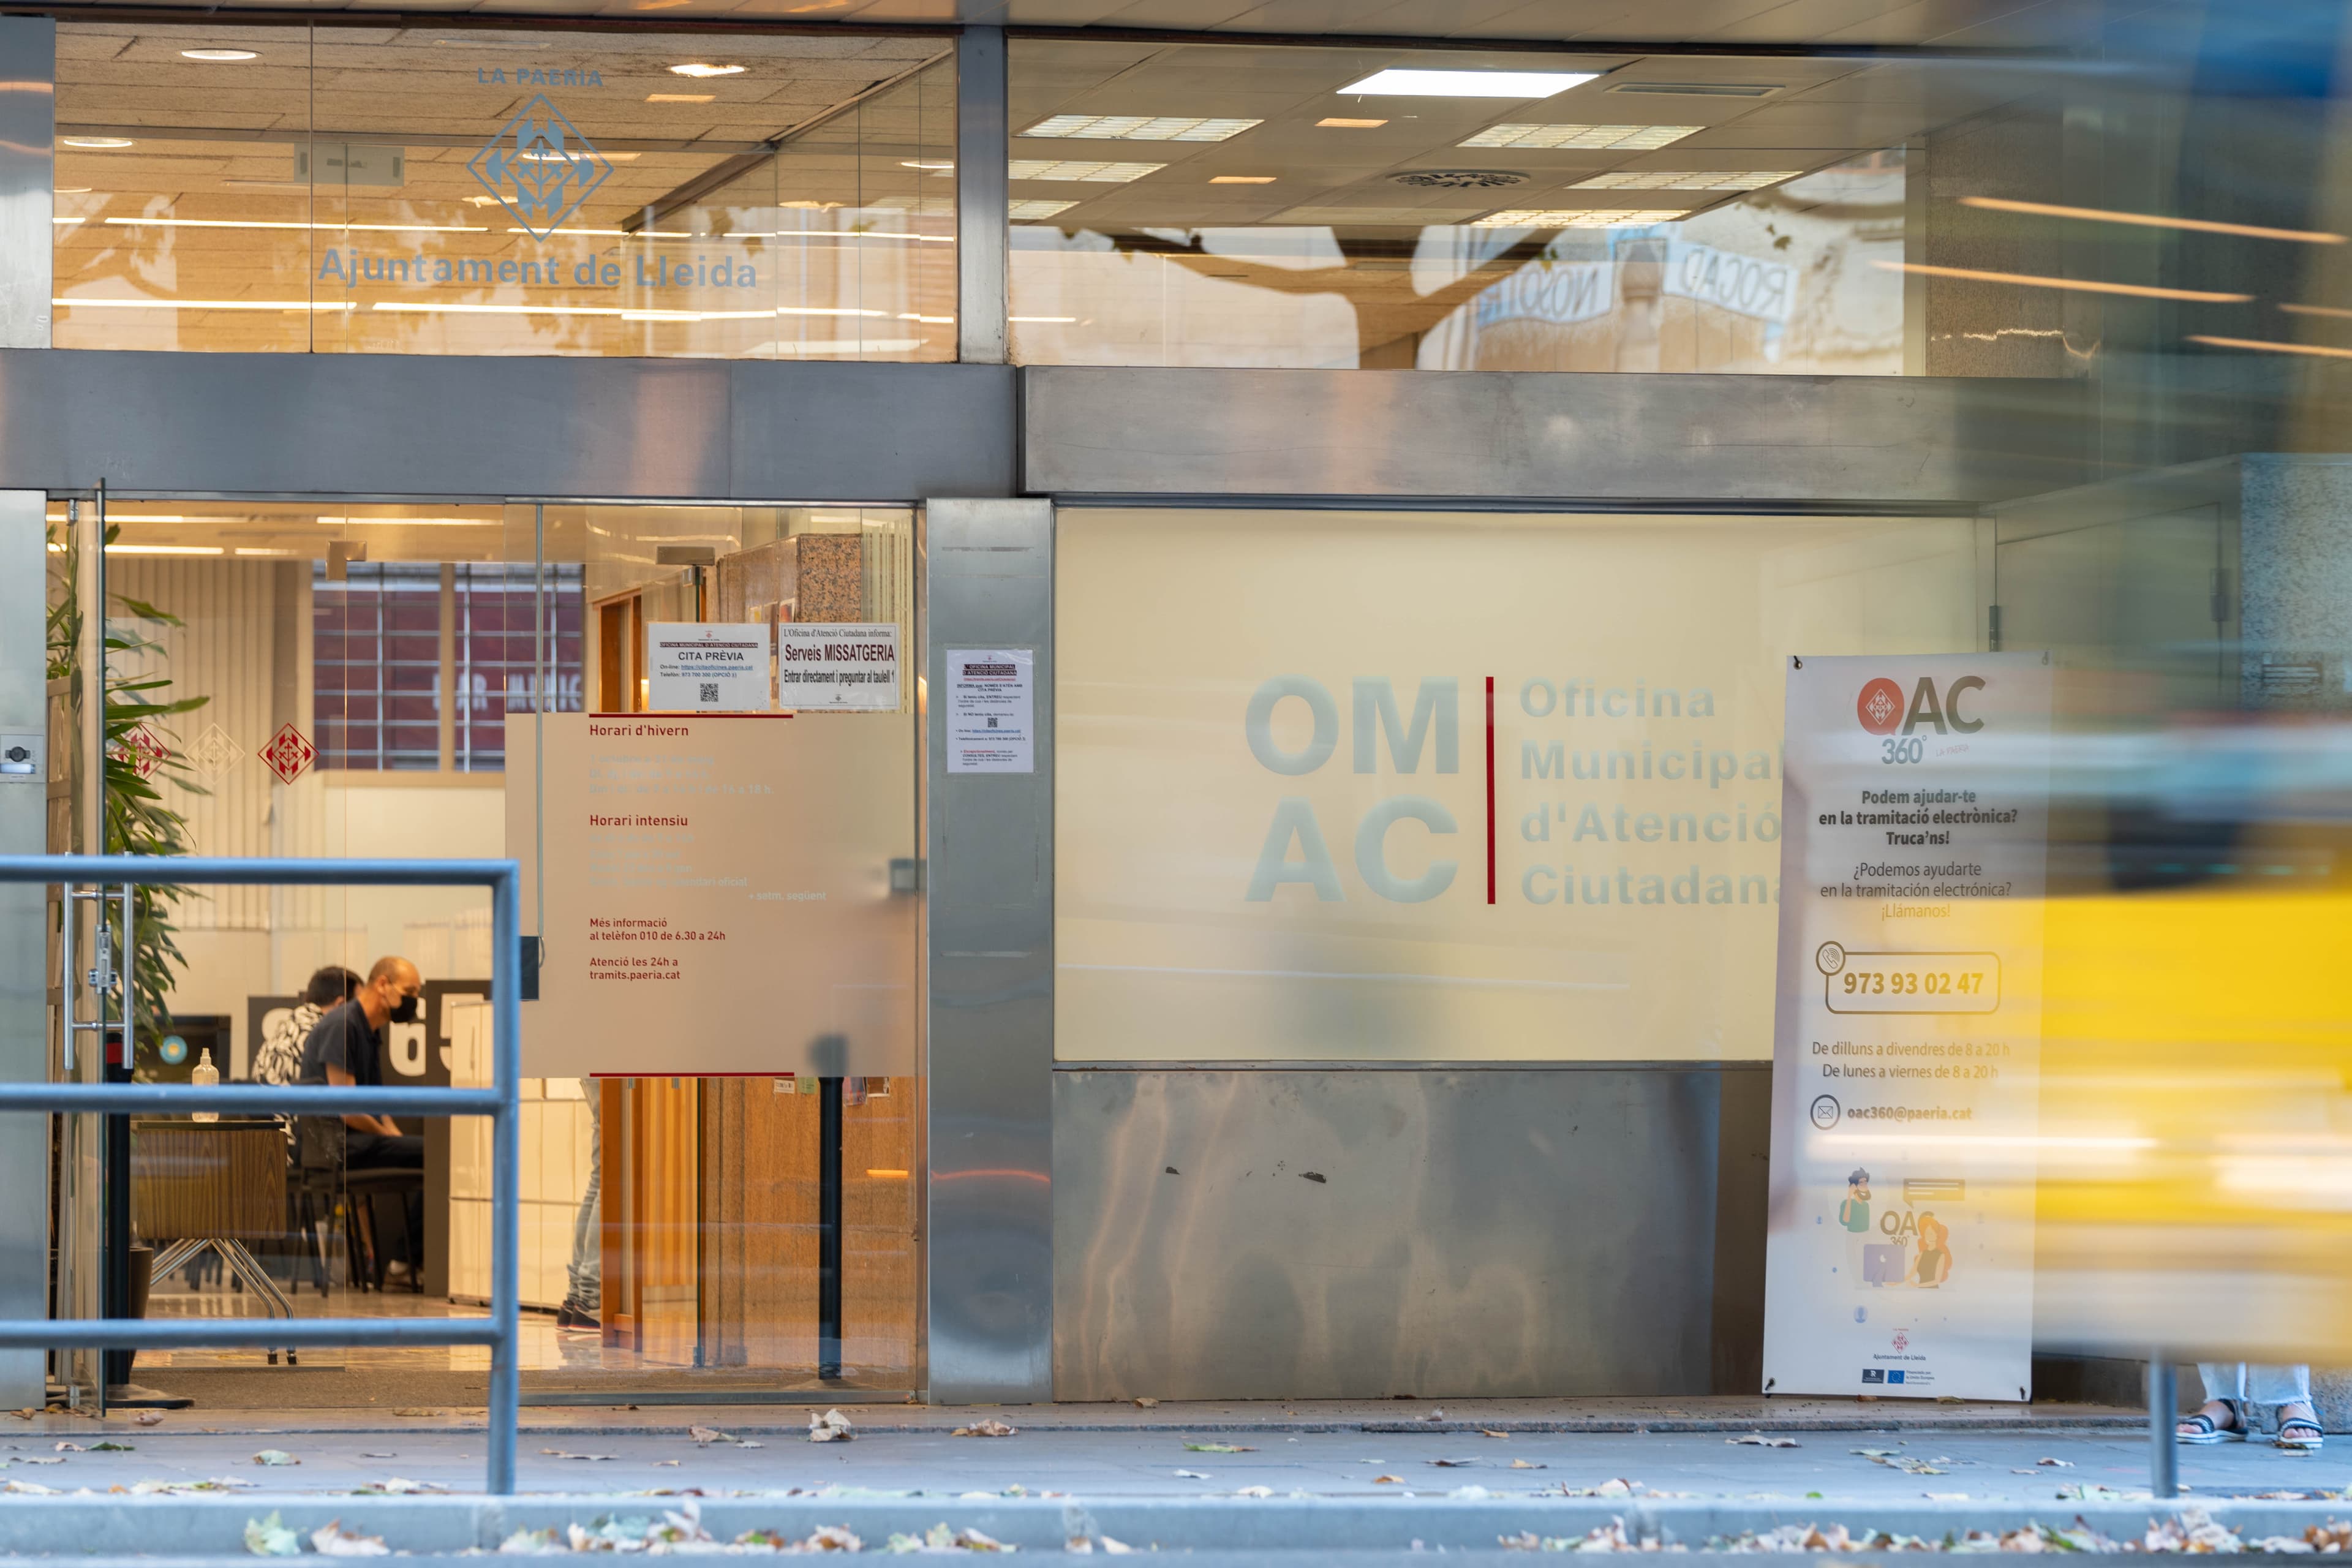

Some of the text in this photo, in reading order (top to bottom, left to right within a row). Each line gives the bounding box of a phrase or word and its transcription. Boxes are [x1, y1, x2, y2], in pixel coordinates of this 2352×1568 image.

[478, 67, 603, 88] LA PAERIA
[318, 249, 757, 288] Ajuntament de Lleida
[868, 629, 892, 638] informa:
[678, 650, 744, 660] CITA PRÈVIA
[785, 644, 895, 661] Serveis MISSATGERIA
[784, 669, 801, 683] Entrar
[802, 669, 835, 683] directament
[836, 669, 839, 683] i
[839, 671, 866, 686] preguntar
[867, 669, 872, 683] al
[873, 669, 890, 683] taulell
[1520, 677, 1715, 718] Oficina
[590, 724, 689, 736] Horari d'hivern
[1245, 674, 1459, 776] OM
[1862, 789, 1976, 808] Podem ajudar-te
[590, 815, 688, 826] Horari intensiu
[1521, 801, 1781, 843] d'Atenció
[1819, 807, 2018, 825] en la tramitació electrònica?
[1886, 831, 1950, 845] Truca'ns!
[1245, 795, 1459, 903] AC
[1853, 861, 1981, 880] ¿Podemos ayudarte
[718, 876, 748, 887] oficial
[1521, 864, 1780, 905] Ciutadan
[1820, 881, 2012, 897] en la tramitación electrónica?
[1882, 903, 1950, 922] ¡Llámanos!
[590, 917, 668, 928] Més informació
[590, 931, 599, 941] al
[601, 930, 637, 941] telèfon
[640, 932, 658, 941] 010
[660, 931, 673, 941] de
[675, 931, 696, 941] 6.30
[707, 931, 726, 941] 24h
[590, 957, 629, 967] Atenció
[632, 957, 647, 967] les
[650, 957, 669, 967] 24h
[590, 970, 680, 981] tramits.paeria.cat
[1844, 973, 1984, 994] 973 93 02 47
[1812, 1041, 2010, 1056] De dilluns a divendres de 8 a 20 h
[1823, 1064, 1998, 1078] De lunes a viernes de 8 a 20 h
[1847, 1105, 1972, 1122] oac360@paeria.cat
